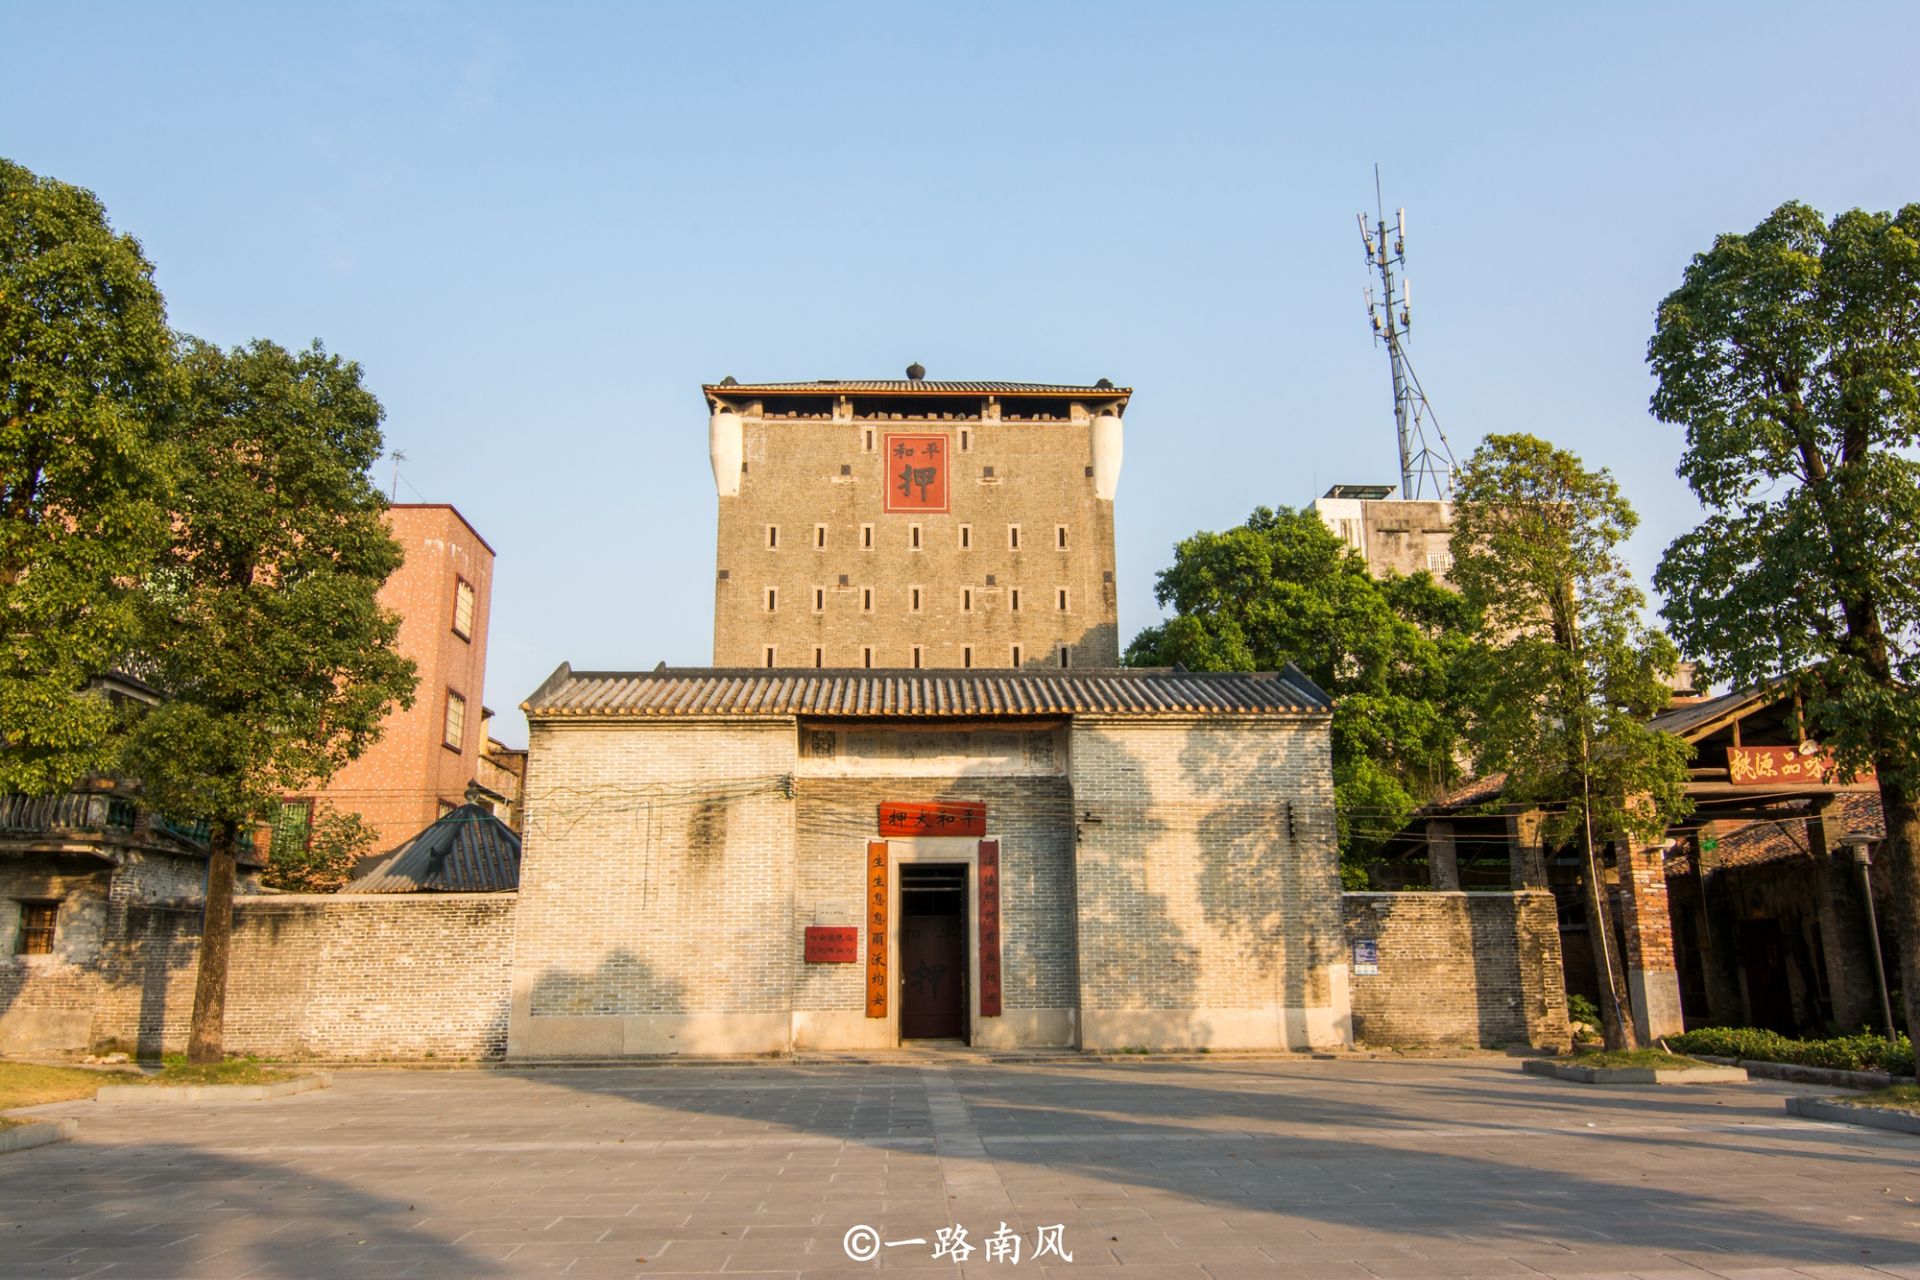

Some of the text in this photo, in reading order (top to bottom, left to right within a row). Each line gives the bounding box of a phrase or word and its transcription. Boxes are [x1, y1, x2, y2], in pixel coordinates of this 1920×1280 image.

[897, 463, 937, 503] 押
[1730, 749, 1876, 781] 桃源品味
